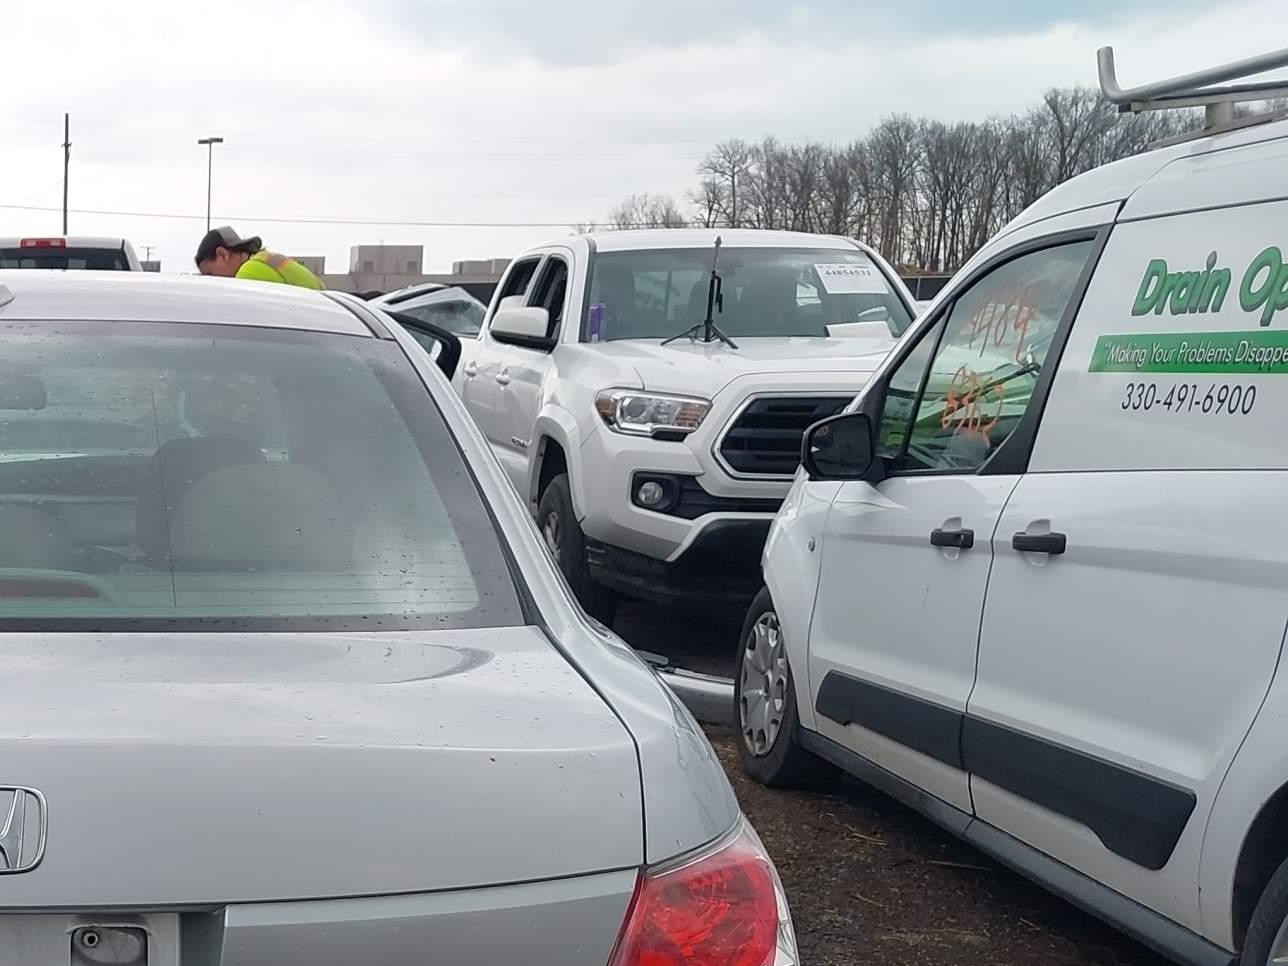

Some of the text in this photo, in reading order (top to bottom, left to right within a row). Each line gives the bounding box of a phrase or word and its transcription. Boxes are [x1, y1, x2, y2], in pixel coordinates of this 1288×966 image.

[1130, 251, 1232, 317] Drain
[1150, 342, 1177, 363] Your
[1177, 340, 1233, 363] Problems
[1121, 382, 1257, 415] 330-491-6900
